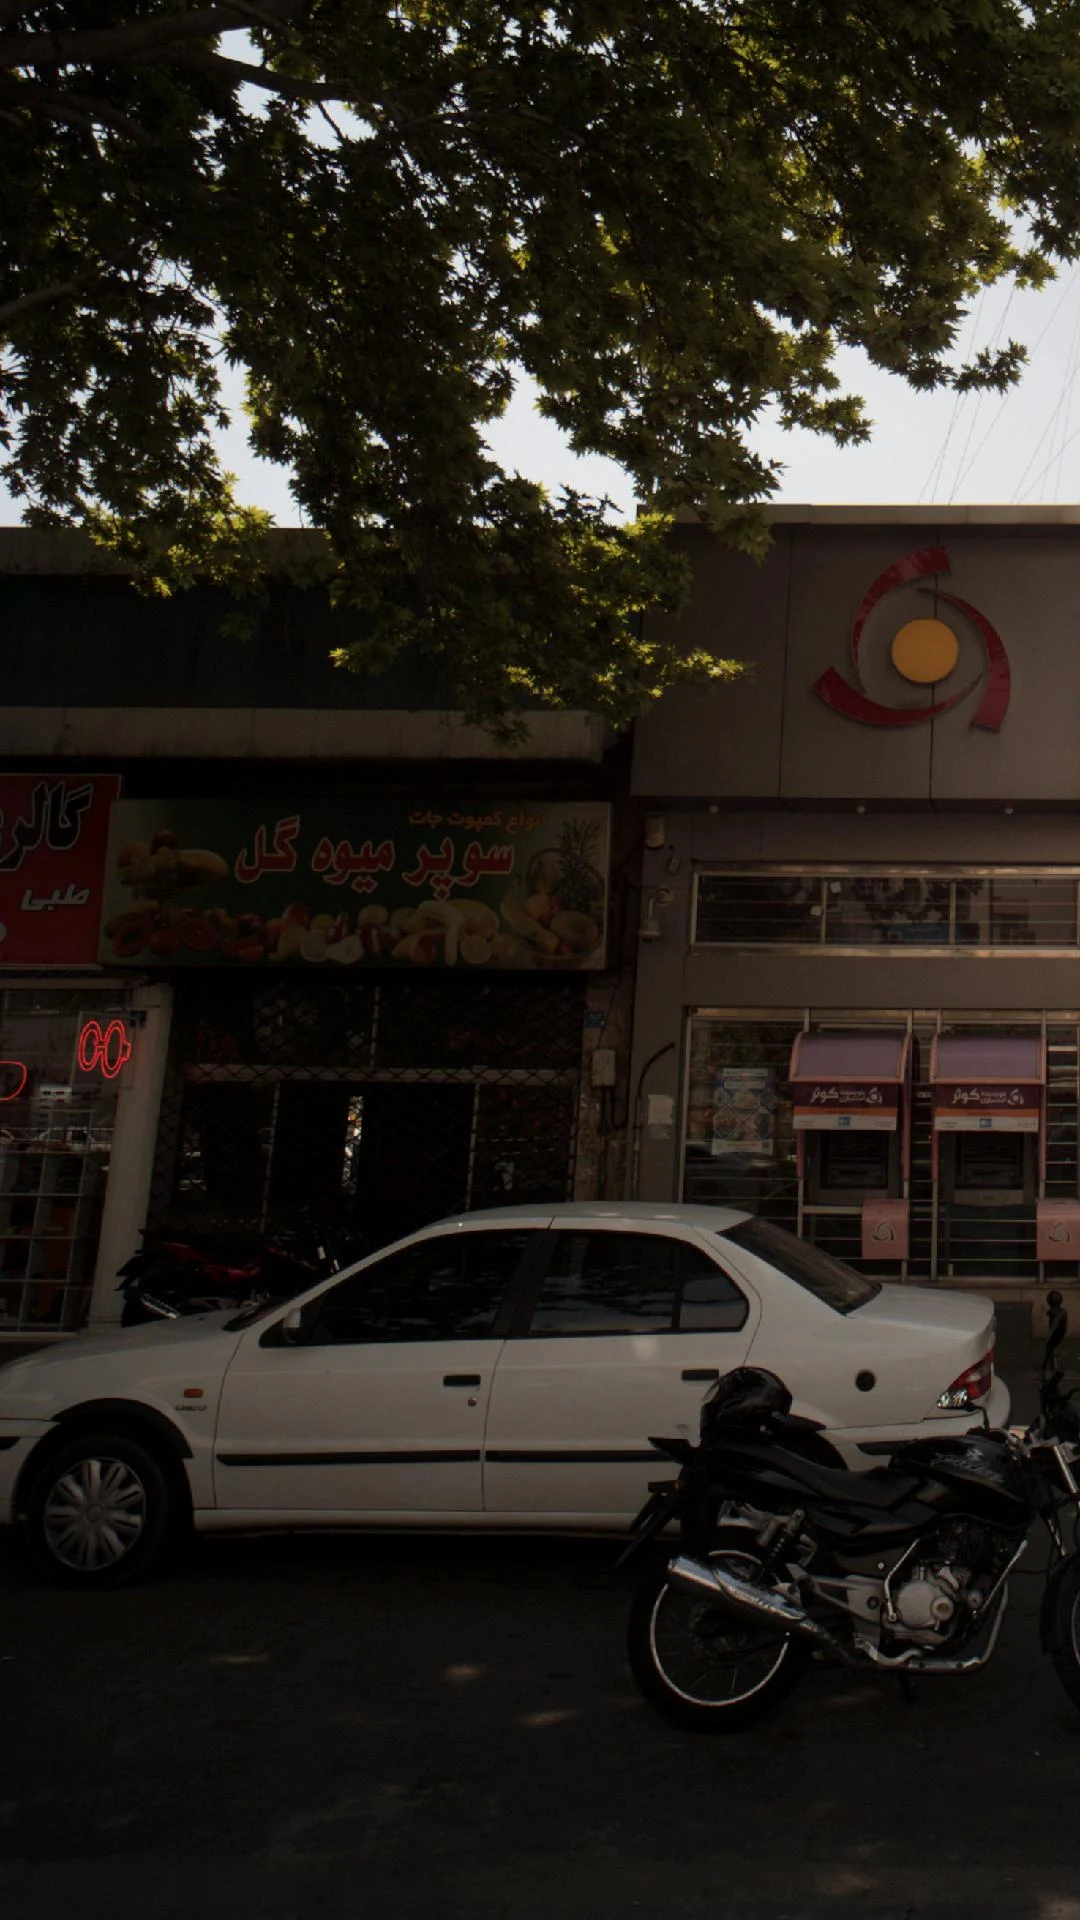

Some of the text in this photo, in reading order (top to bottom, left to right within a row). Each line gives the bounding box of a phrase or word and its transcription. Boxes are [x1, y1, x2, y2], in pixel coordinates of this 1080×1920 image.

[0, 780, 94, 871] گالر
[408, 809, 443, 830] جات
[446, 808, 502, 832] کمپوت
[234, 813, 515, 900] سوپر میوه گل
[20, 883, 91, 911] طبی
